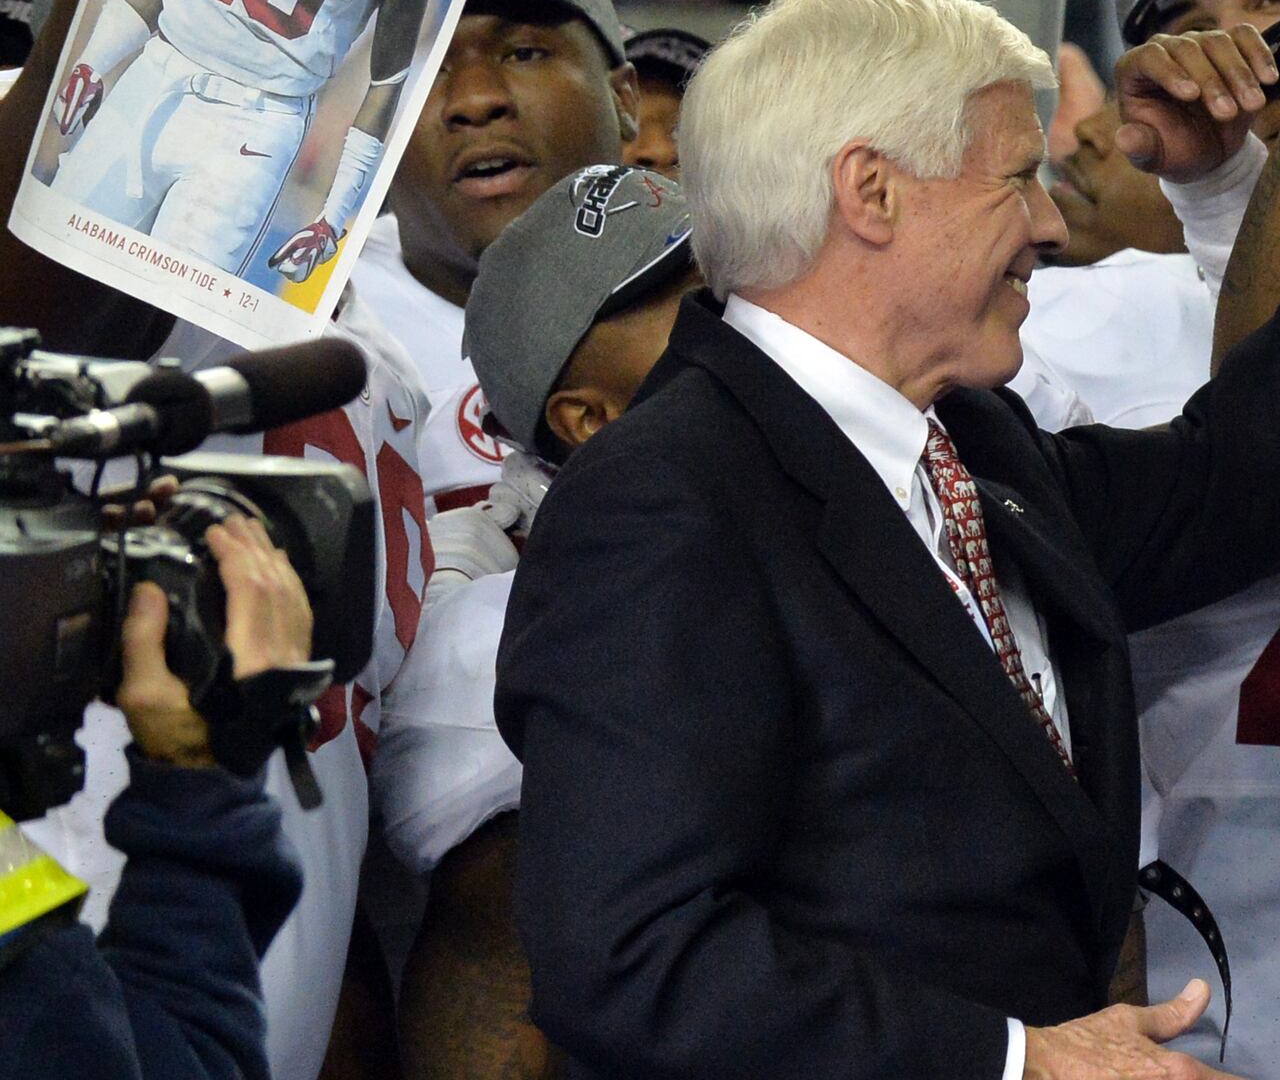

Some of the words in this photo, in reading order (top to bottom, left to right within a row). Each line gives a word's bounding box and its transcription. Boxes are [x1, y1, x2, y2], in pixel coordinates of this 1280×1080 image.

[67, 214, 126, 251] ALABAMA
[128, 242, 189, 278] CRIMSON
[190, 269, 217, 292] TIDE
[238, 292, 260, 313] 12-1
